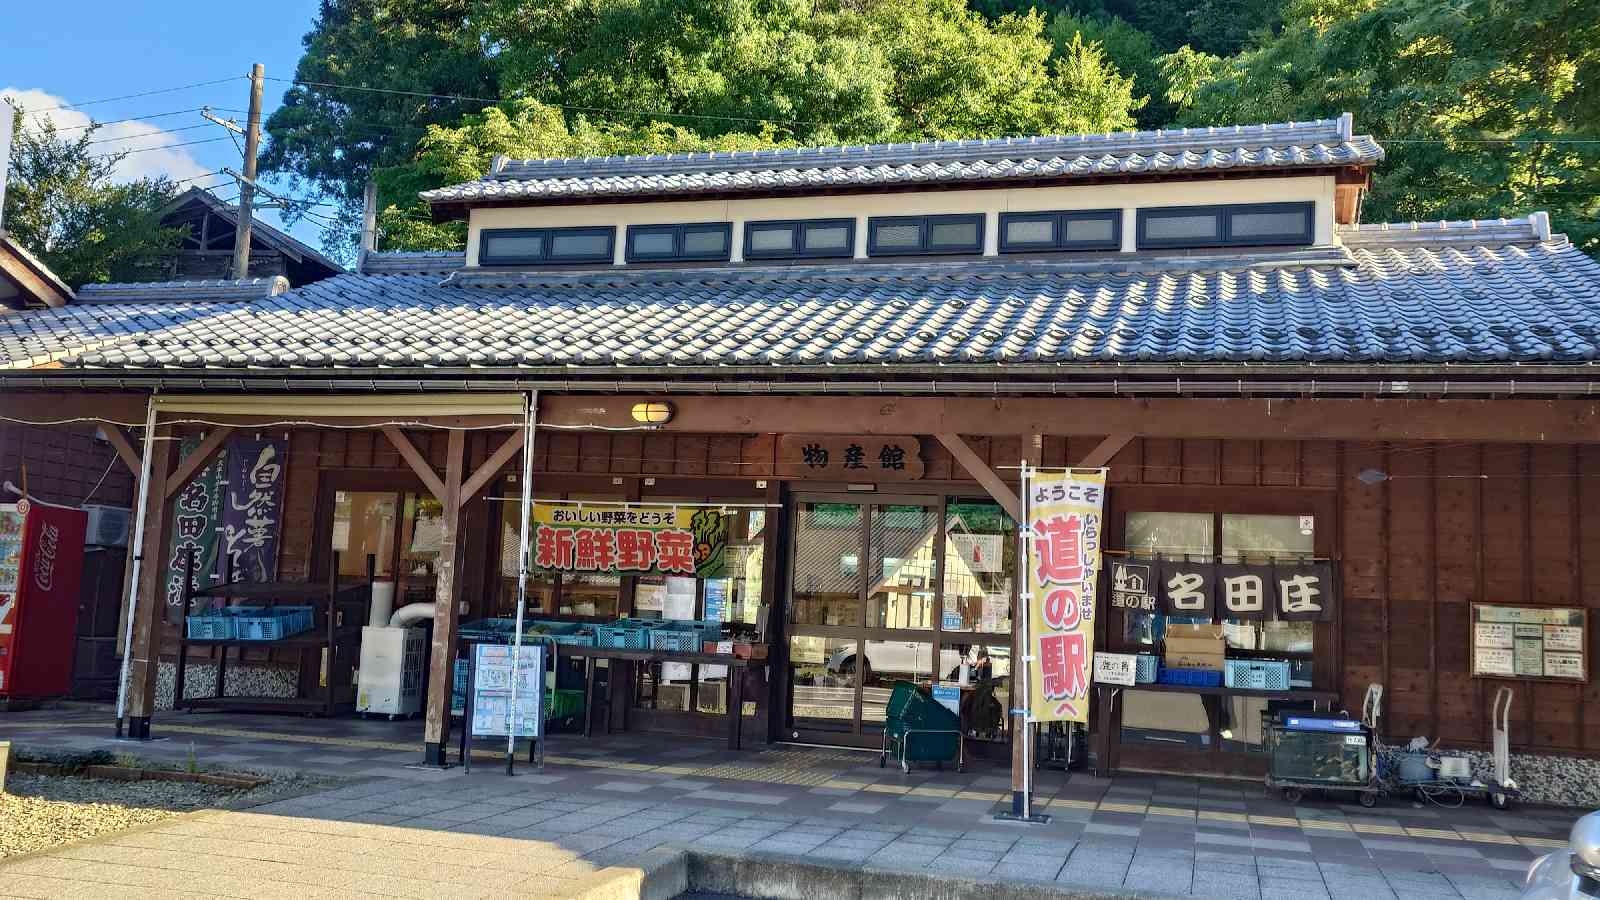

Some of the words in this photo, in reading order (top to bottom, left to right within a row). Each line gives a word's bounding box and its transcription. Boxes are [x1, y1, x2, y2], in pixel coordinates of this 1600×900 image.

[802, 443, 905, 470] 物産館
[1036, 486, 1099, 503] ようこそ
[553, 509, 675, 525] おいしい野菜をどうぞ
[536, 527, 694, 572] 新鮮野菜
[1081, 513, 1099, 620] いらっしゃいませ
[1112, 592, 1156, 610] 道の駅
[1167, 572, 1322, 613] 名田庄
[1033, 513, 1087, 717] 道の駅へ
